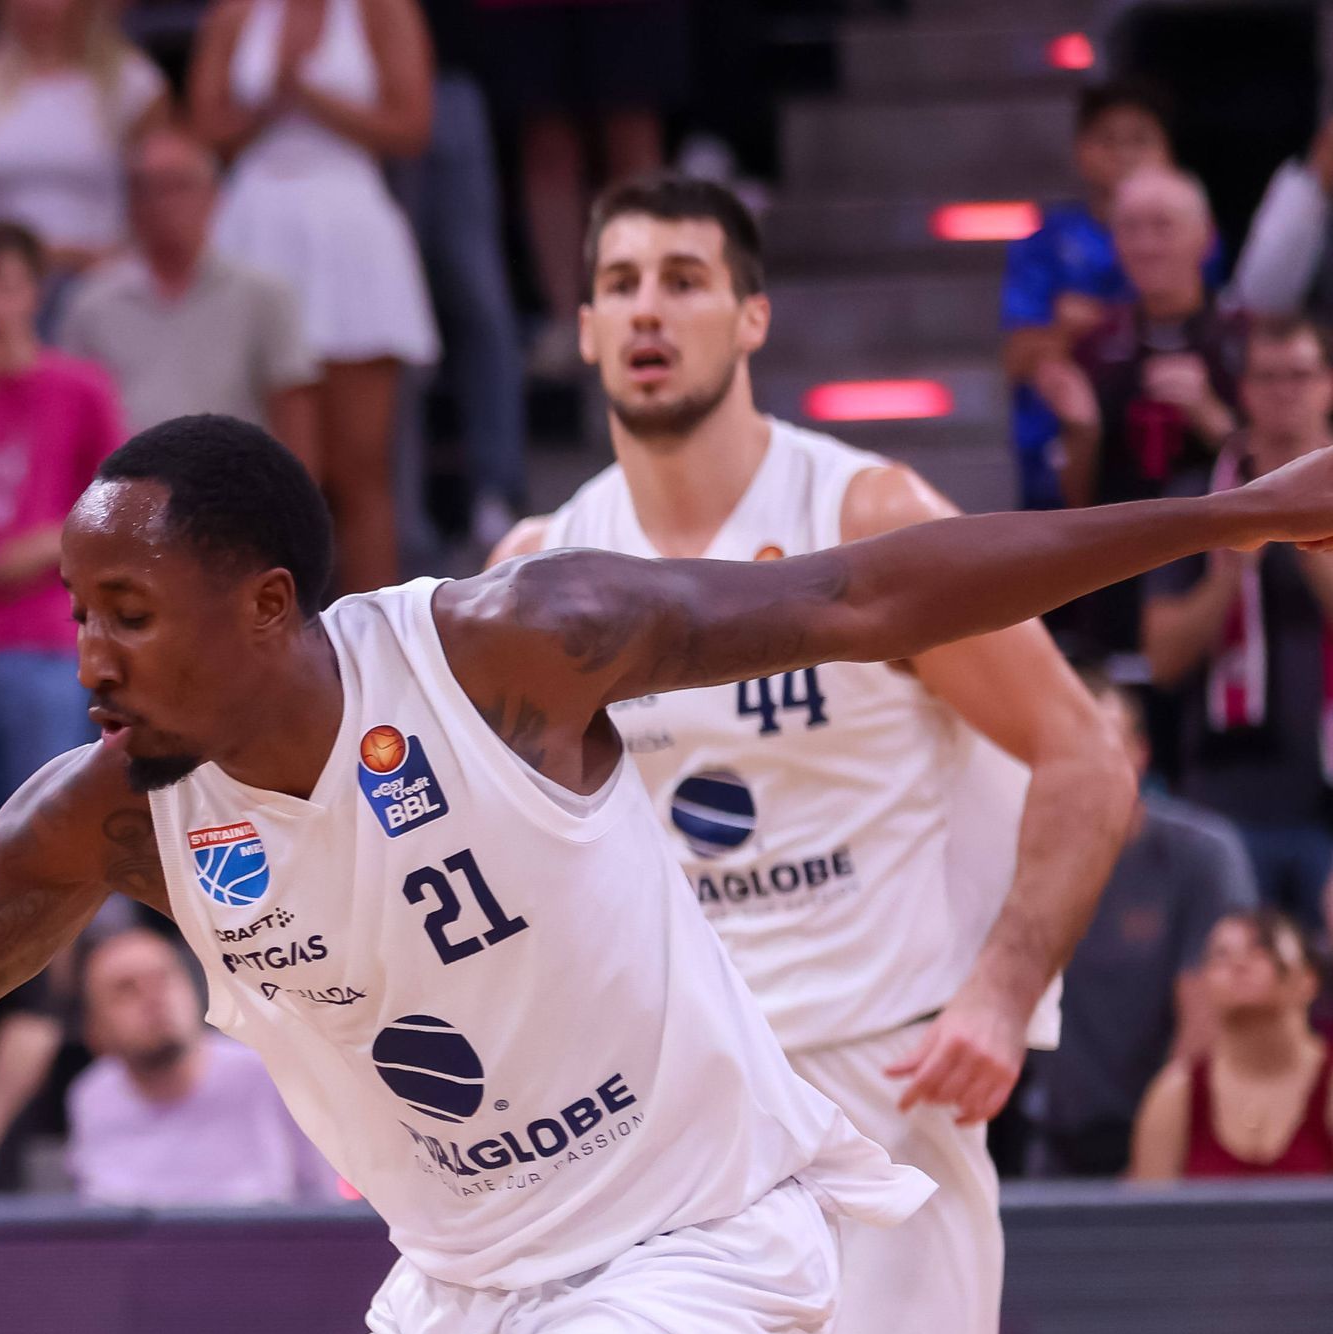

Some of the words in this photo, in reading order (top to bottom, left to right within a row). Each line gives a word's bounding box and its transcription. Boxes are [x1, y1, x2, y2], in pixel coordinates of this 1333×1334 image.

[737, 667, 828, 736] 44
[385, 790, 441, 829] BBL
[214, 914, 275, 942] CRAFT
[402, 848, 530, 965] 21
